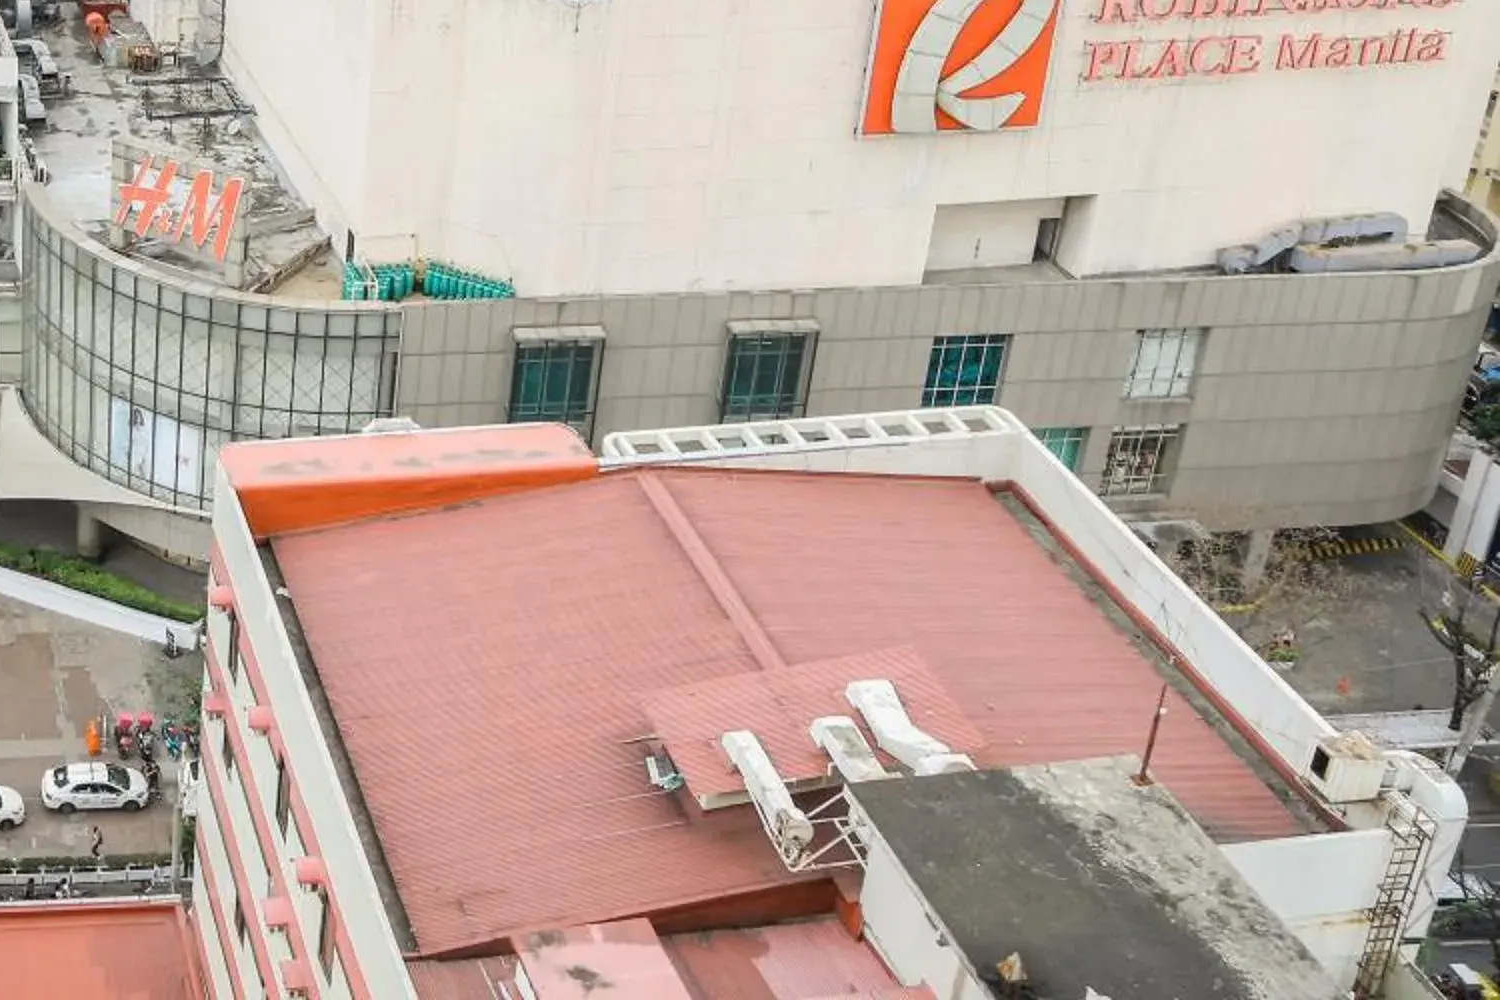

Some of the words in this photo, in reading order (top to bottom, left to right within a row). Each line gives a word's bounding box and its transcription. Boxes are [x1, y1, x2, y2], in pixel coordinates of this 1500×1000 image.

[1083, 34, 1262, 82] PLACE
[1275, 27, 1447, 71] Manila
[114, 154, 244, 266] H&M
